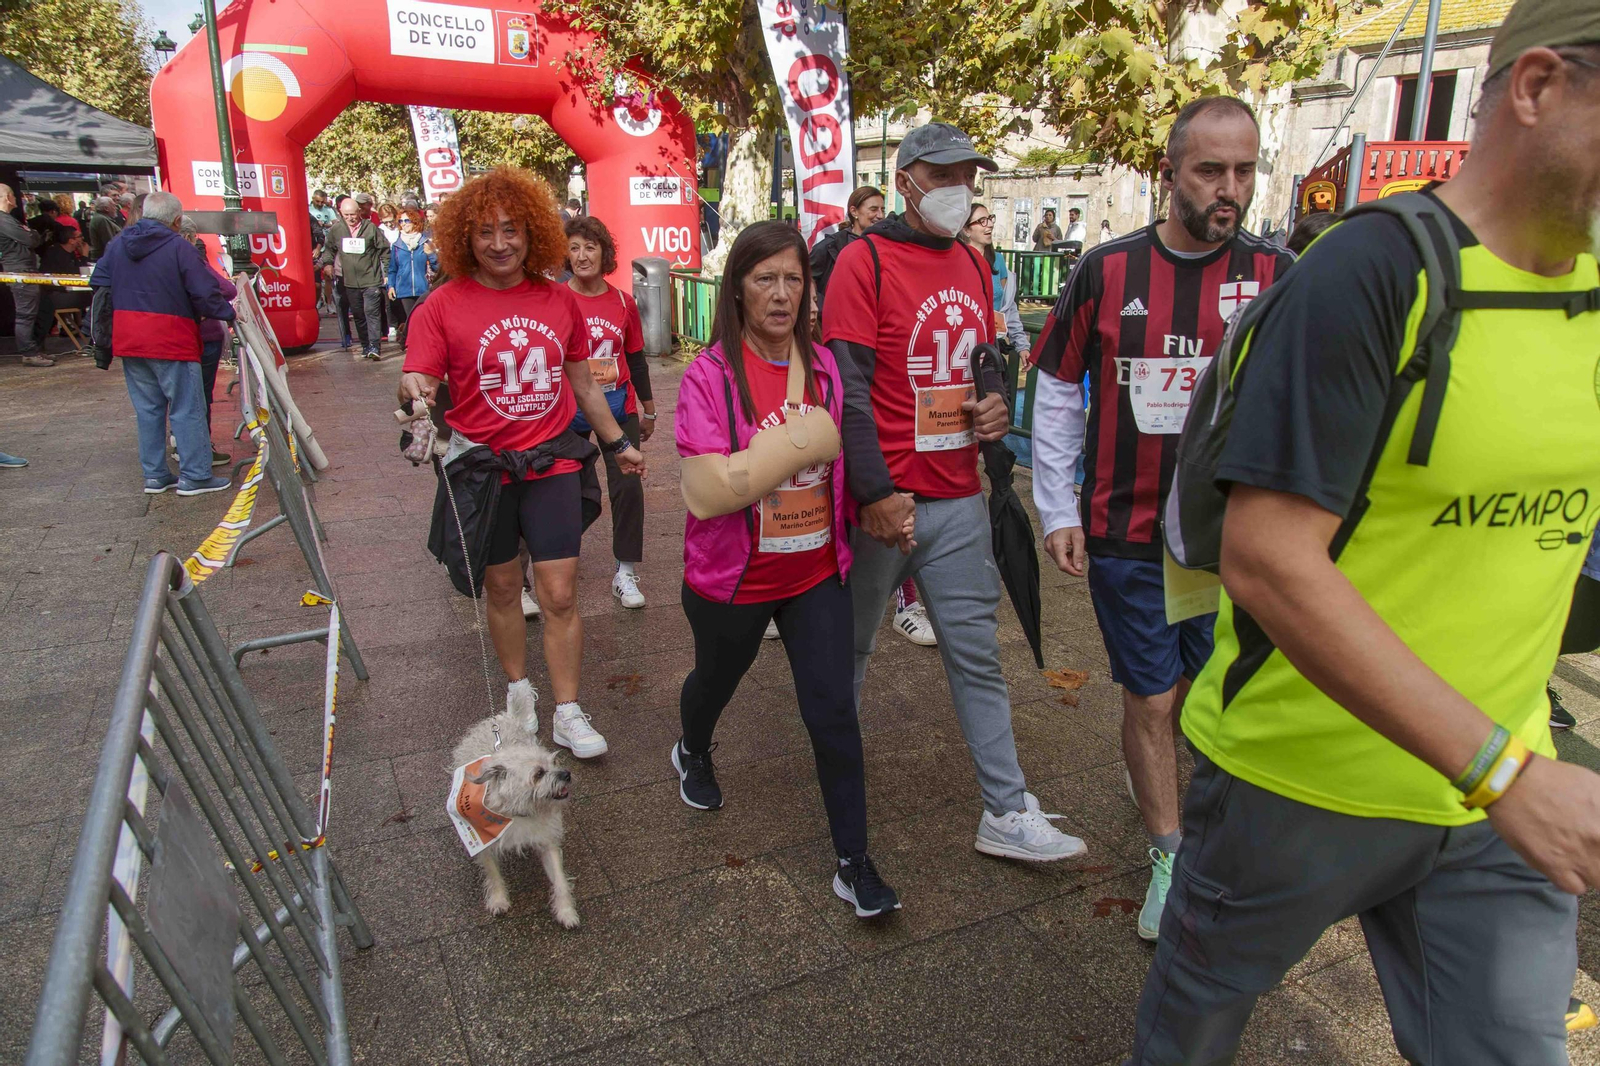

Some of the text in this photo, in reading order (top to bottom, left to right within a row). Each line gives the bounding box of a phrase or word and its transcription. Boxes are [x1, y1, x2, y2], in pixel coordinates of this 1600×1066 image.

[397, 10, 485, 32] CONCELLO
[409, 29, 476, 49] DE VIGO
[788, 54, 844, 251] VIGO
[205, 180, 220, 188] DE
[634, 182, 678, 190] CONCELLO
[641, 226, 691, 253] VIGO
[916, 286, 984, 323] #EU MÓVOME
[479, 314, 556, 347] #EU MÓVOME
[586, 316, 622, 336] MÓVOME
[932, 328, 977, 384] 14
[1163, 334, 1203, 358] Fly
[497, 346, 551, 394] 14
[496, 393, 554, 405] POLA ESCLEROSE
[508, 402, 546, 413] MÚLTIPLE
[929, 409, 959, 419] Manuel
[772, 511, 799, 521] María
[801, 508, 814, 519] Del
[1431, 488, 1589, 527] AVEMPO
